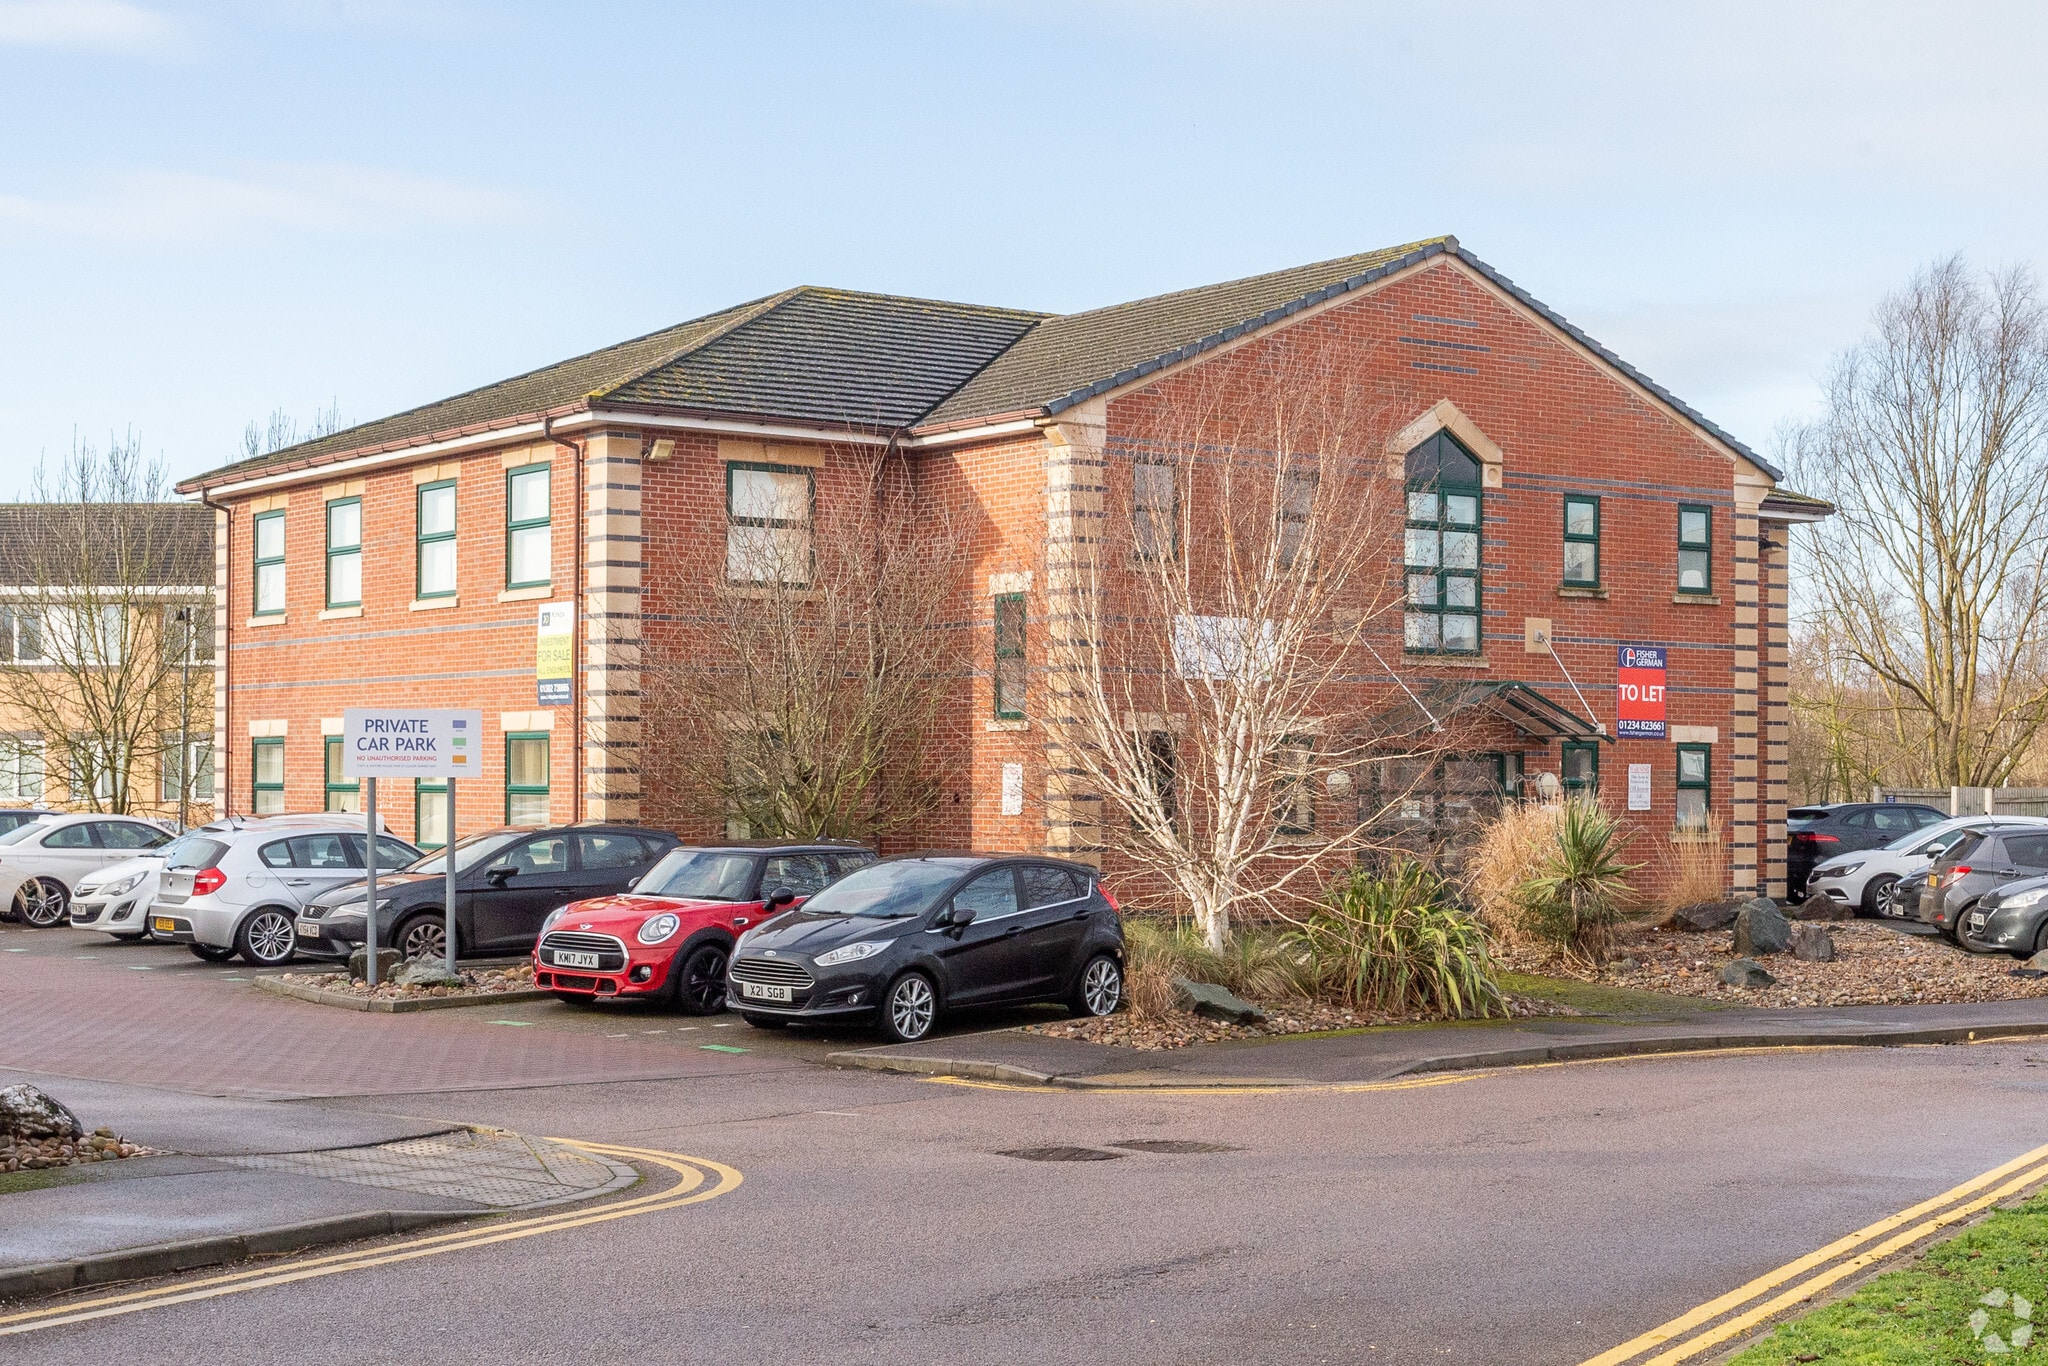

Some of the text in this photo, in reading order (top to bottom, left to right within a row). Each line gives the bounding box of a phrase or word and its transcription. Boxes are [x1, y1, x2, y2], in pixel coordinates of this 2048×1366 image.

[538, 649, 571, 662] FOR SALE
[1636, 650, 1657, 659] FISHER
[1636, 658, 1663, 667] GERMAN
[1619, 684, 1665, 702] TO LET
[365, 719, 429, 733] PRIVATE
[1618, 720, 1664, 731] 01234 823661
[357, 737, 437, 751] CAR PARK
[558, 952, 594, 966] KM17 JYX
[750, 984, 785, 999] X21 SGB
